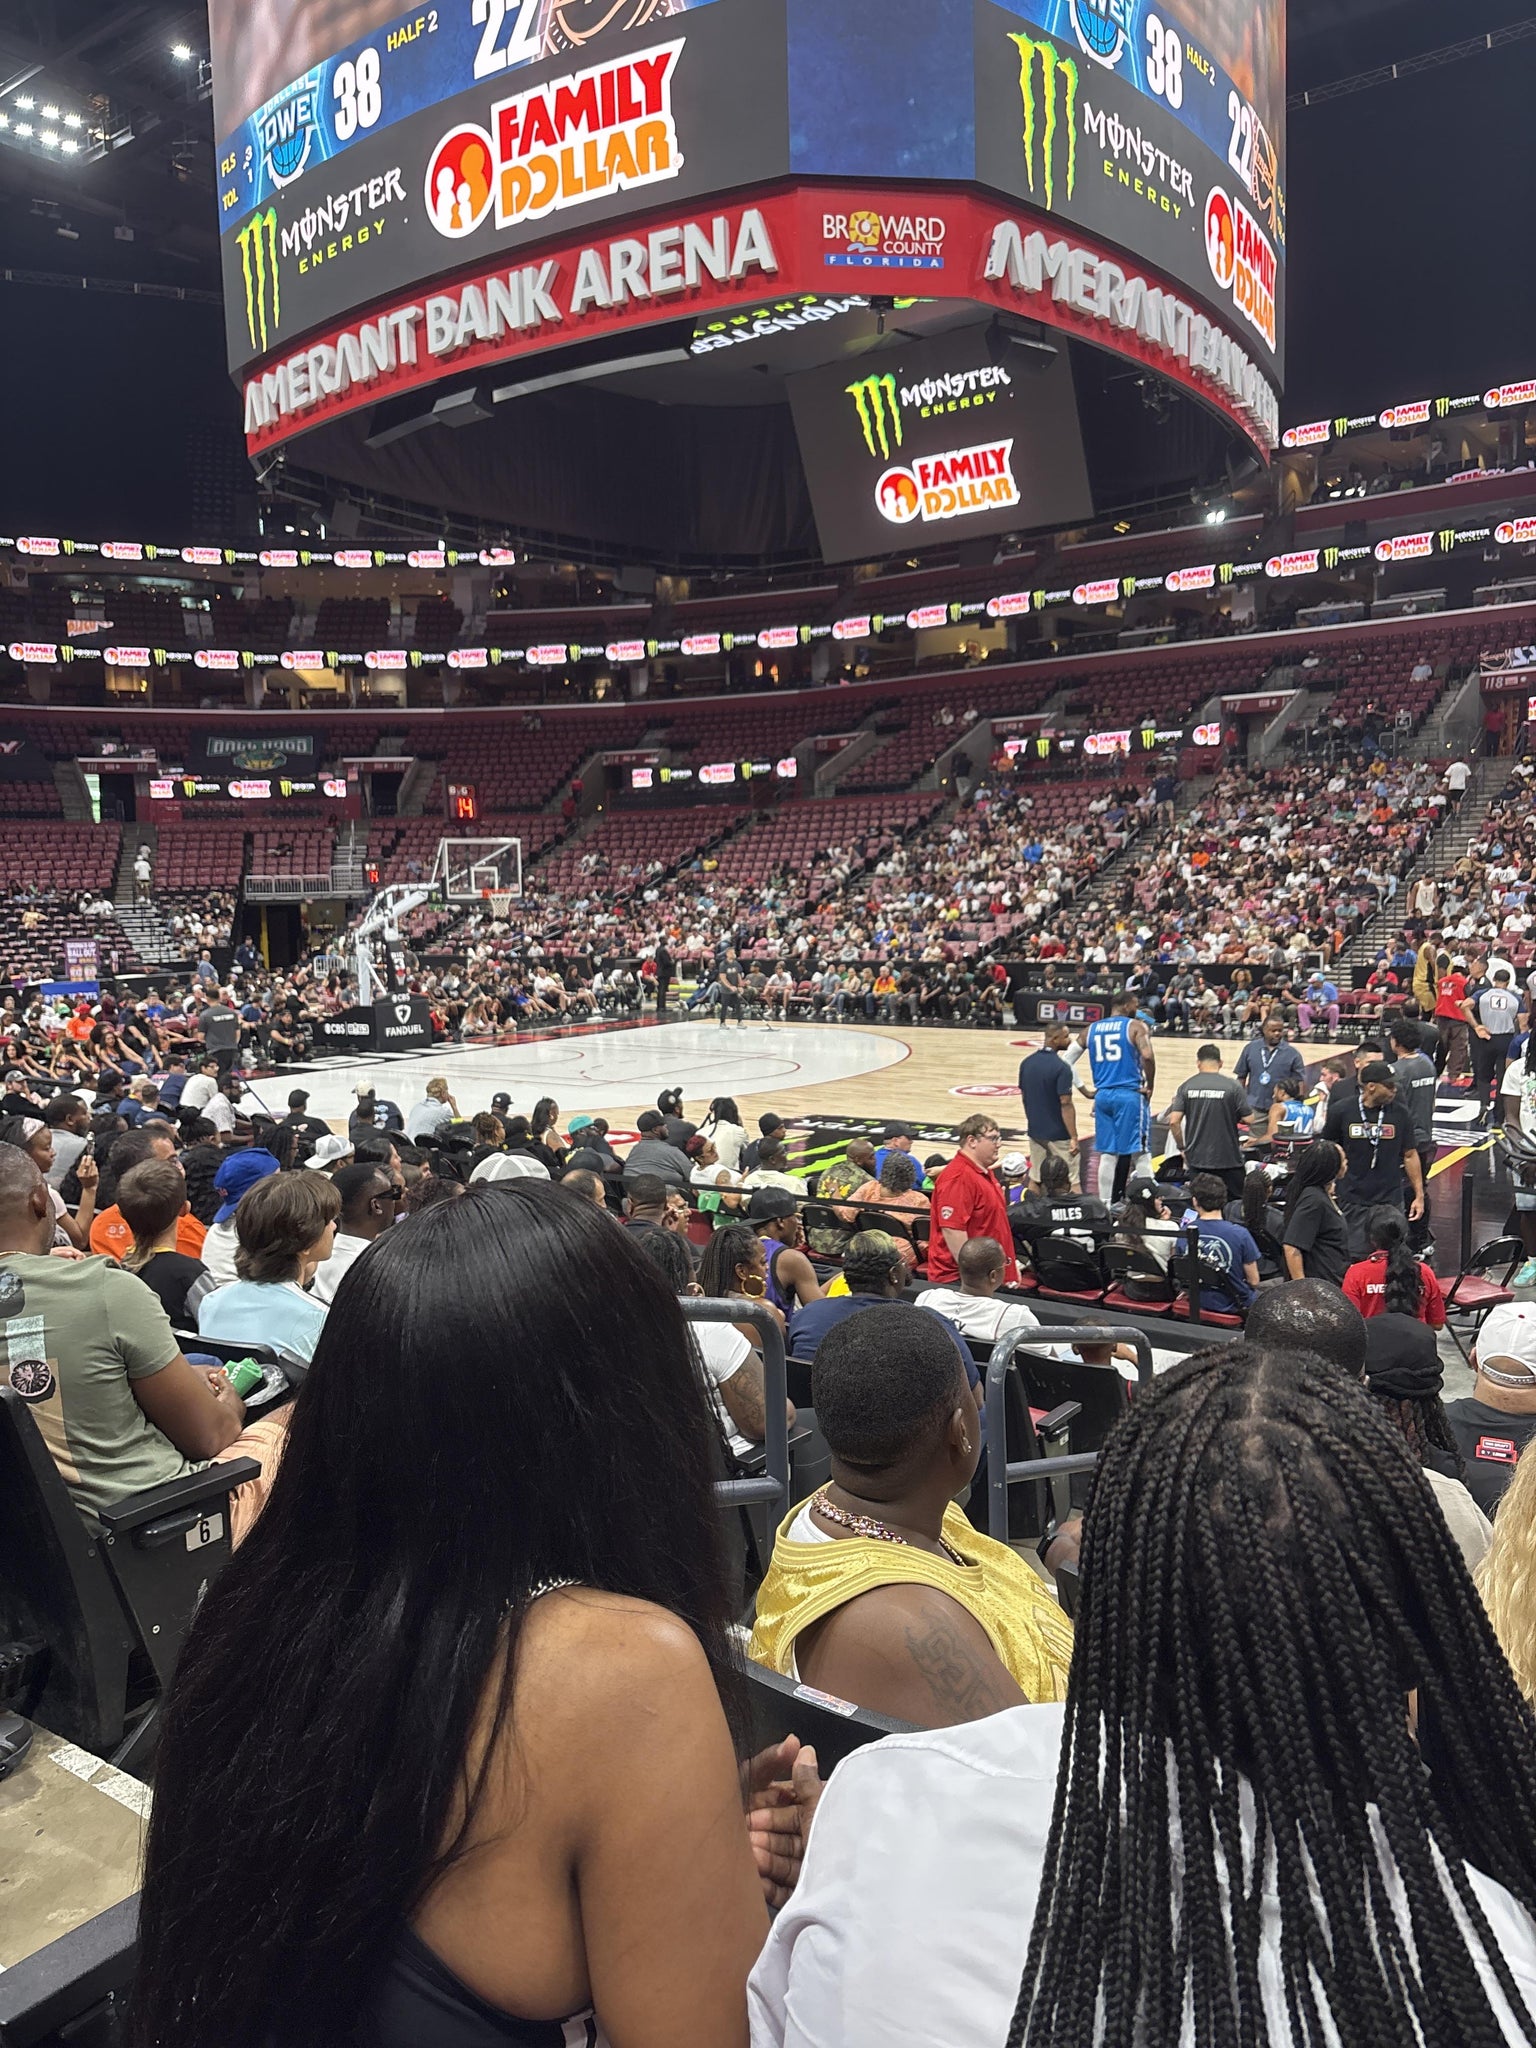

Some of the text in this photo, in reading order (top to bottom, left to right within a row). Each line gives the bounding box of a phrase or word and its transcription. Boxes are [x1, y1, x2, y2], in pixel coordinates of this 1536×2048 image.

[386, 12, 439, 52] HALF 2
[471, 0, 542, 80] 22
[1146, 14, 1182, 109] 38
[1186, 43, 1215, 86] HALF 2
[333, 48, 382, 141] 38
[499, 52, 672, 162] FAMILY
[1228, 90, 1251, 193] 22
[221, 152, 236, 177] FLS
[501, 120, 670, 217] DOLLAR
[222, 188, 238, 211] TOL
[1103, 159, 1181, 219] ENERGY
[299, 218, 386, 274] ENERGY
[883, 241, 943, 255] COUNTY
[1236, 207, 1276, 300] FAMILY
[829, 256, 940, 268] FLORIDA
[984, 220, 1197, 370] AMERANT
[1236, 257, 1275, 346] DOLLAR
[243, 208, 778, 434] AMERANT BANK ARENA
[1502, 384, 1535, 394] FAMILY
[1502, 392, 1535, 402] DOLLAR
[920, 390, 996, 419] ENERGY
[1396, 404, 1427, 416] FAMILY
[1298, 424, 1327, 436] FAMILY
[1397, 412, 1427, 423] DOLLAR
[919, 445, 1008, 489] FAMILY
[923, 475, 1014, 516] DOLLAR
[1394, 536, 1429, 548] FAMILY
[1394, 546, 1429, 556] DOLLAR
[1283, 554, 1315, 564] FAMILY
[1284, 562, 1315, 572] DOLLAR
[1485, 677, 1503, 690] 118
[457, 798, 475, 818] 14
[331, 1024, 345, 1034] CBS
[386, 1025, 424, 1037] FANDUEL
[1093, 1033, 1122, 1062] 15
[1052, 1207, 1082, 1221] MILES
[200, 1520, 210, 1544] 6
